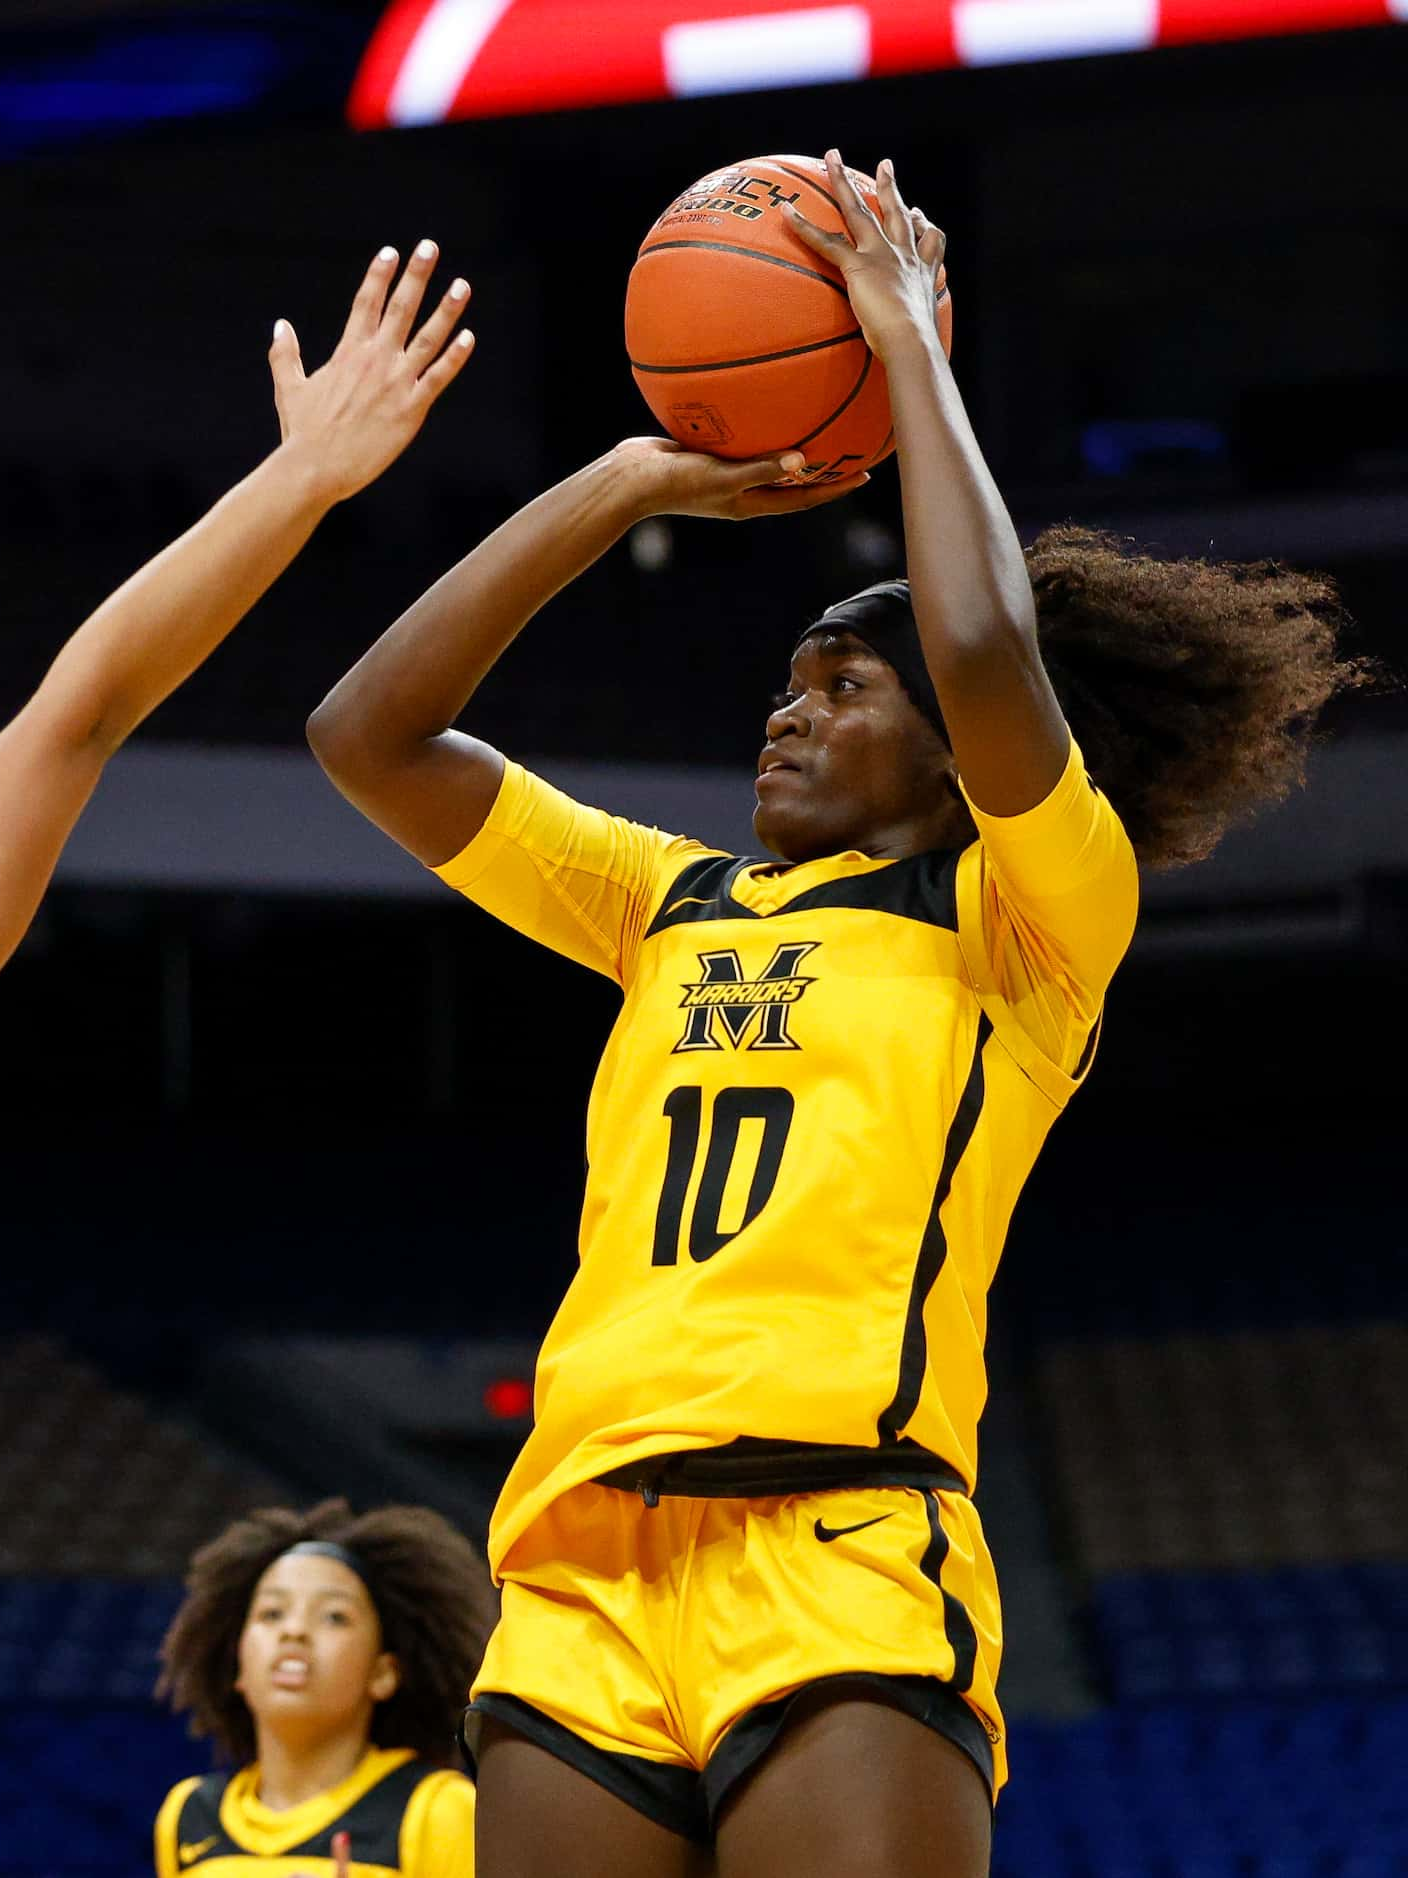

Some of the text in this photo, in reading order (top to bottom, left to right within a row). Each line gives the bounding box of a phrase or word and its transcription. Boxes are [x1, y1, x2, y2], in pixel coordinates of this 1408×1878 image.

[671, 941, 823, 1055] M
[681, 978, 816, 1007] WARRIORS
[651, 1085, 796, 1266] 10
